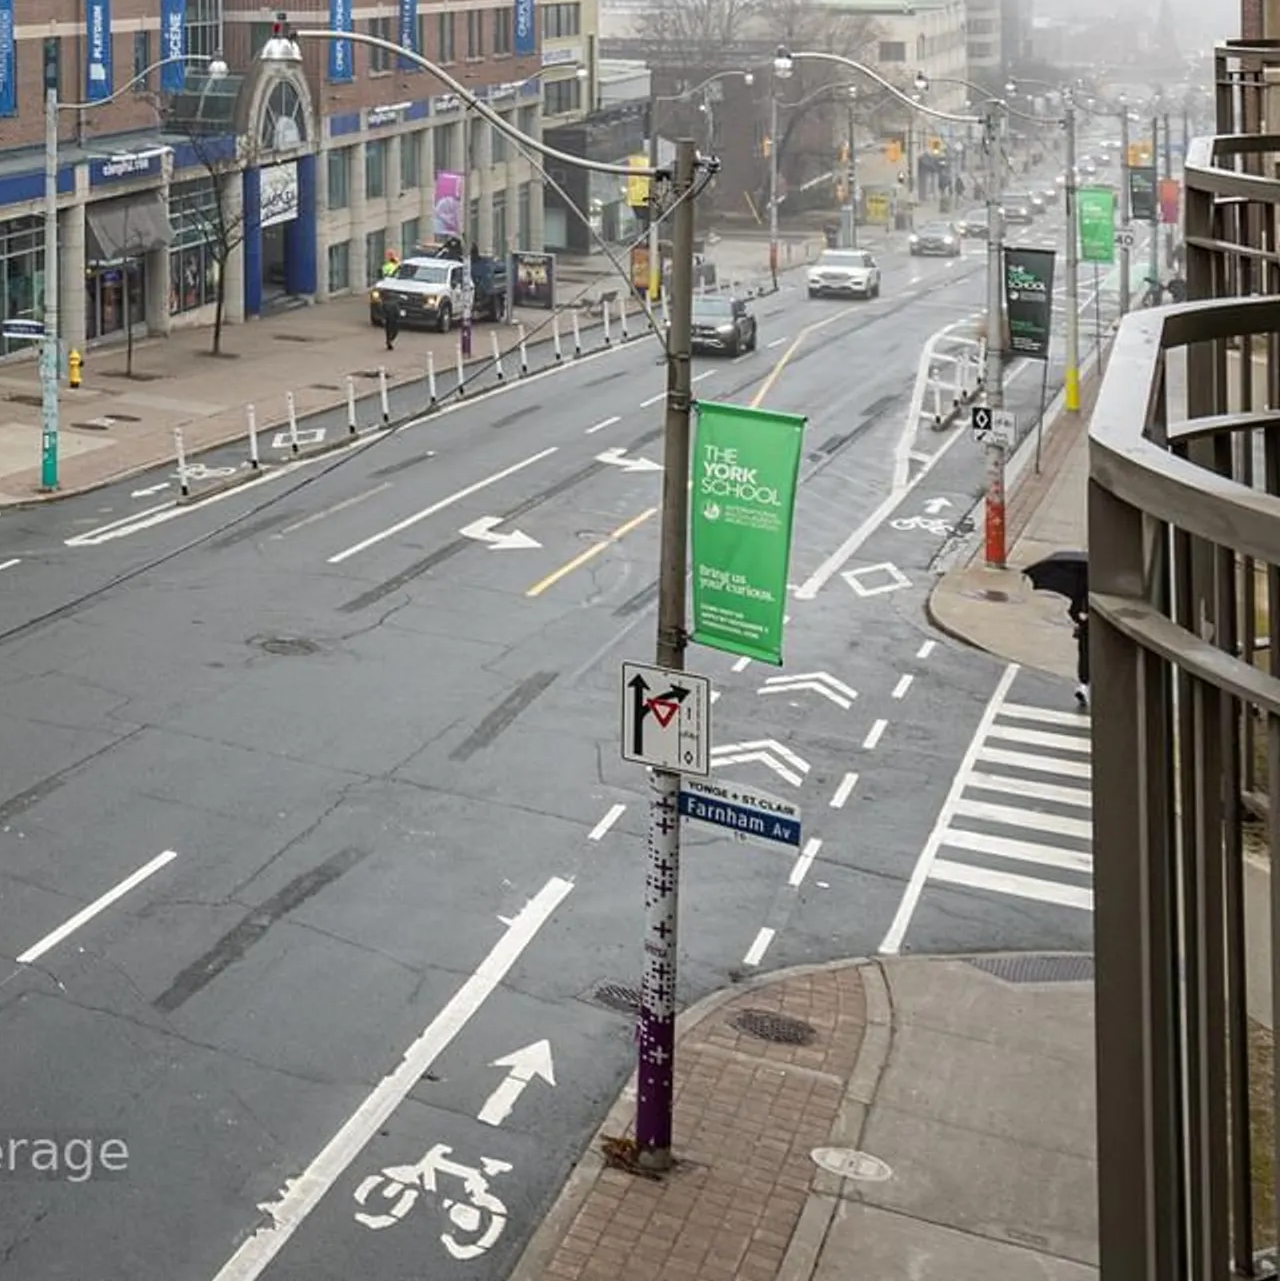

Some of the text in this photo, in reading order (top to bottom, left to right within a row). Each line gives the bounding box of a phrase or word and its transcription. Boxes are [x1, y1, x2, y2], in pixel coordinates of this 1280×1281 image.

[92, 5, 103, 59] PLAYDIUM
[703, 444, 738, 464] THE
[703, 460, 758, 485] YORK
[701, 477, 782, 506] SCHOOL
[732, 574, 747, 585] us
[687, 780, 728, 799] YONGE
[759, 800, 796, 816] CLAIR
[687, 797, 792, 840] Farnham Av
